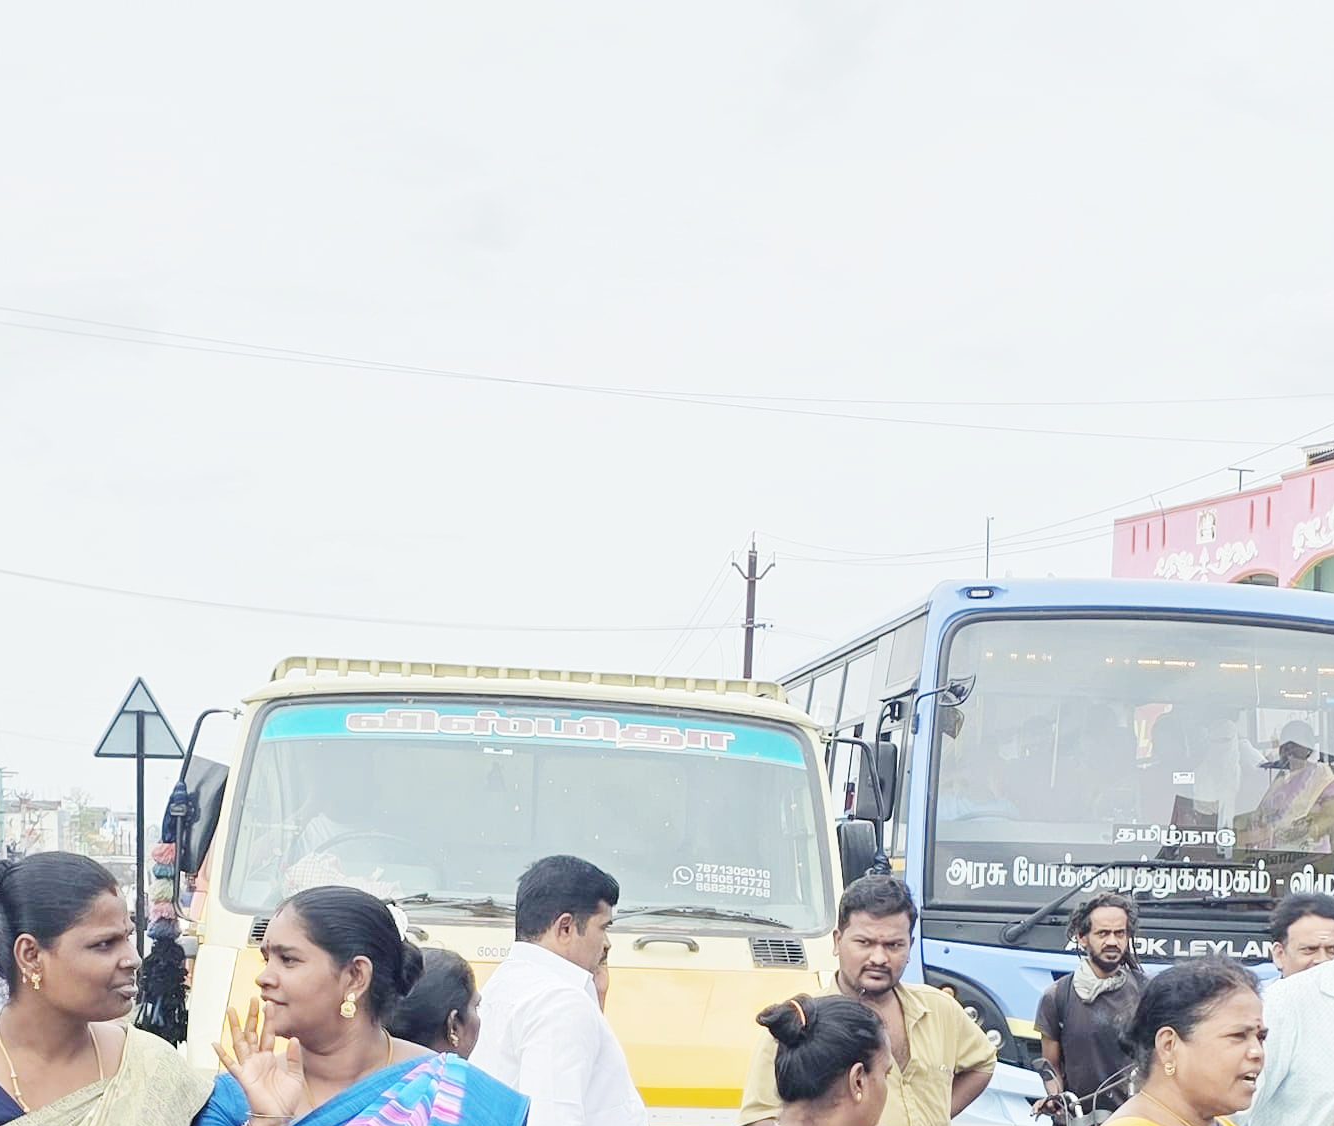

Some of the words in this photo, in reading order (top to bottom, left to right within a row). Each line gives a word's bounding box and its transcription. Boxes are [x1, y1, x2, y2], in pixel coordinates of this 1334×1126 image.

[1114, 822, 1236, 847] தமிழ்நாடு
[695, 863, 770, 879] 7871302010
[945, 857, 1008, 890] அரசு
[1174, 940, 1280, 959] LEYLAN
